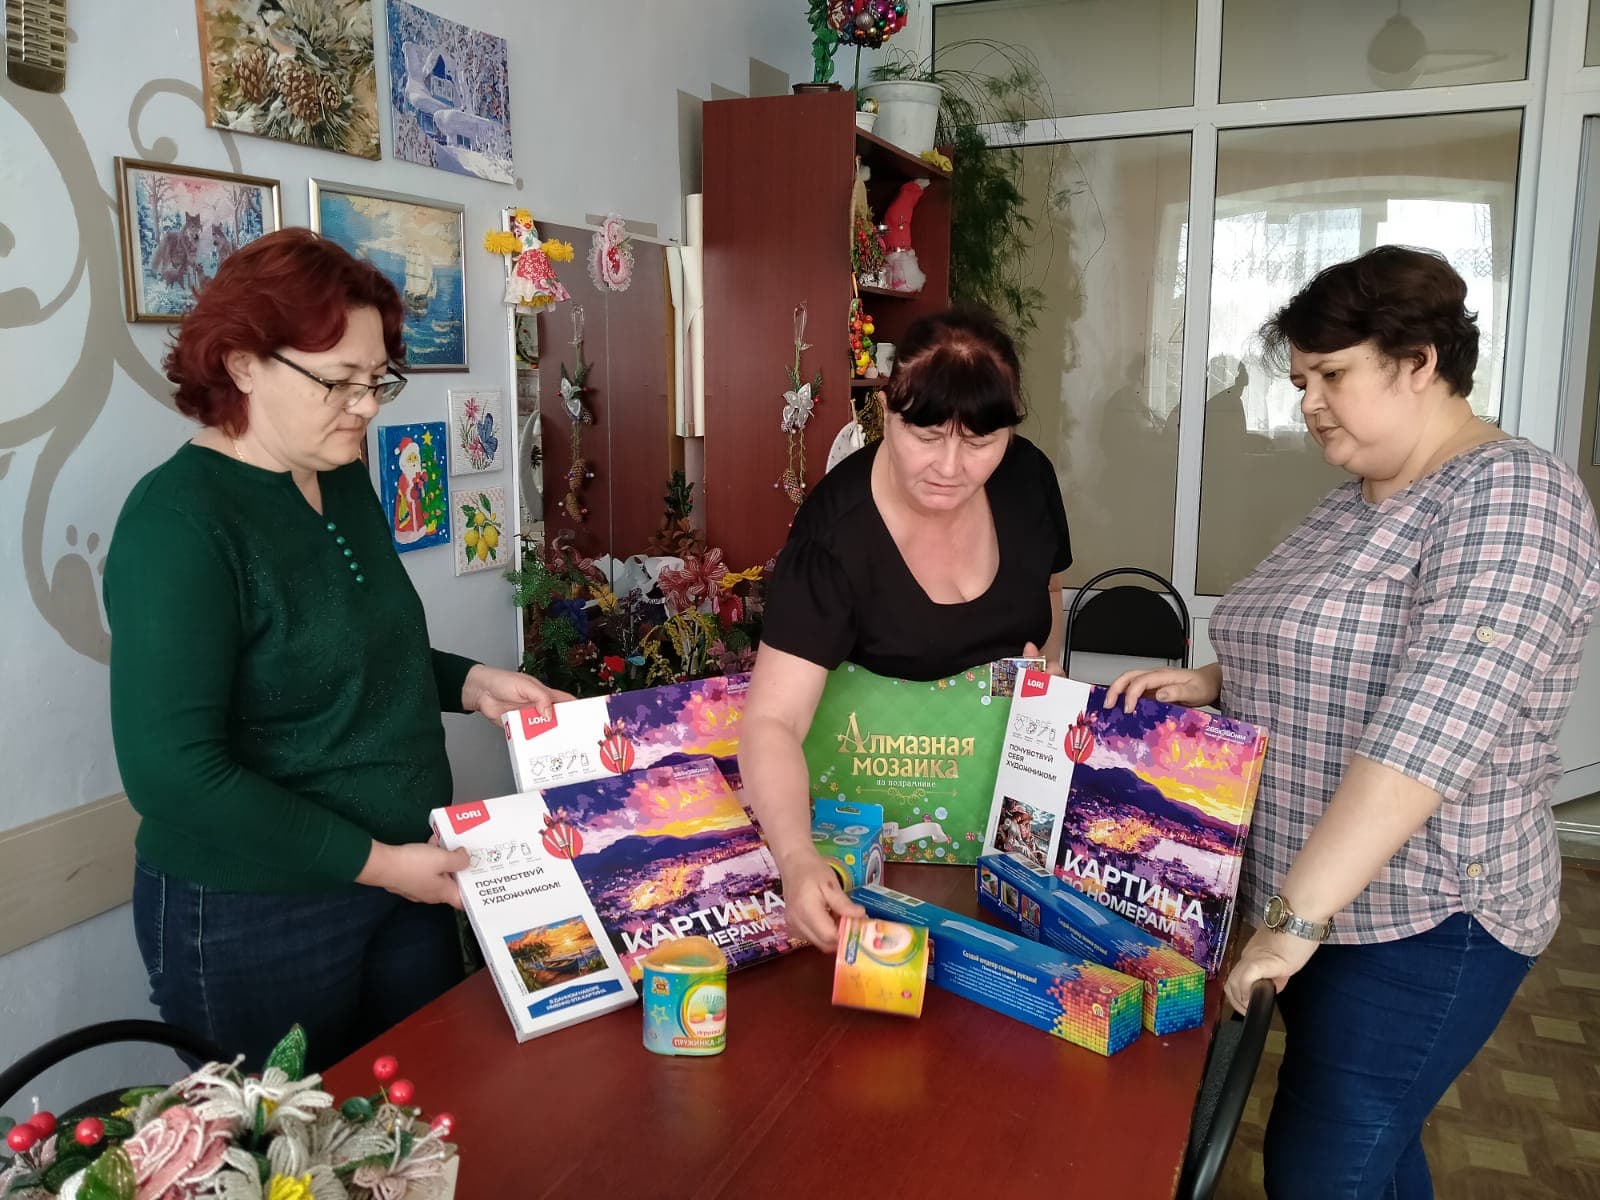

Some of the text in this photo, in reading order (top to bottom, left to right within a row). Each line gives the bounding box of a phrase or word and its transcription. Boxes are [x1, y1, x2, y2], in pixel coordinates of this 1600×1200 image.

[1027, 679, 1044, 689] LORI
[837, 711, 975, 757] Алмазная
[1007, 752, 1024, 763] СЕБЯ
[1009, 743, 1054, 763] ПОЧУВСТВУЙ
[851, 756, 959, 779] мозаика
[1006, 759, 1057, 782] ХУДОЖНИКОМ!
[456, 810, 482, 821] LORI
[475, 866, 544, 888] ПОЧУВСТВУЙ
[479, 885, 507, 897] СЕБЯ
[482, 881, 562, 906] ХУДОЖНИКОМ!
[1064, 850, 1204, 929] КАРТИНА
[621, 890, 785, 953] КАРТИНА
[706, 918, 772, 947] МЕРАМ
